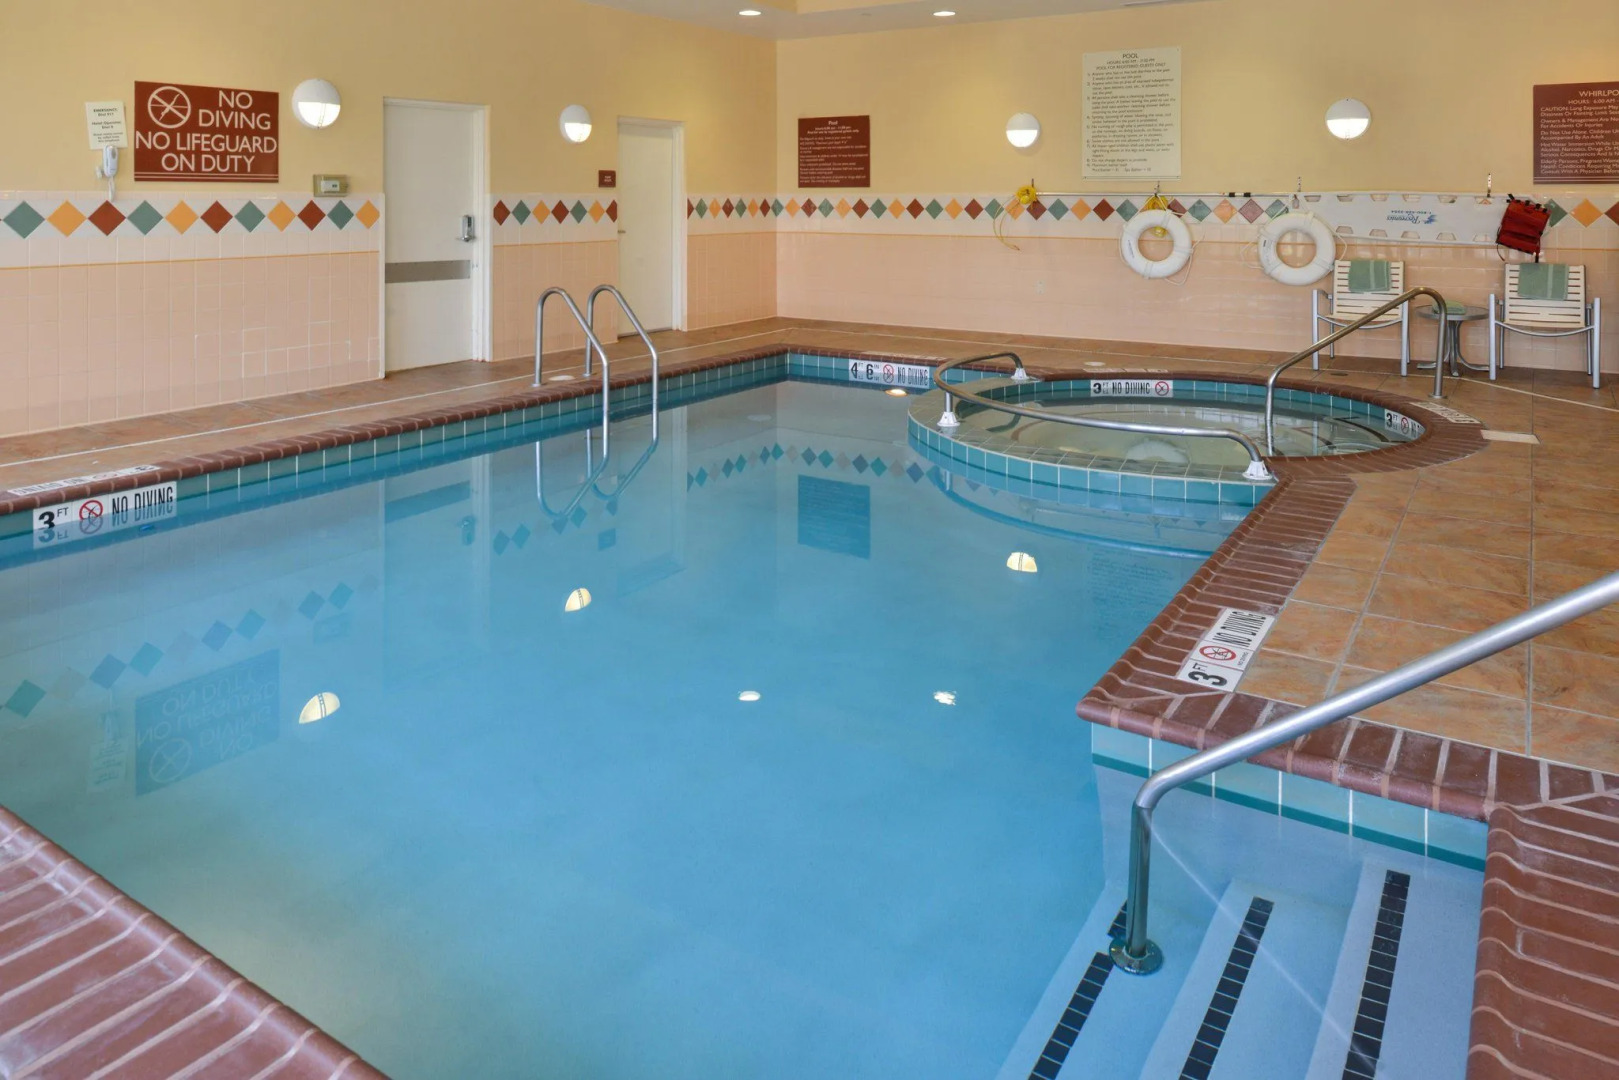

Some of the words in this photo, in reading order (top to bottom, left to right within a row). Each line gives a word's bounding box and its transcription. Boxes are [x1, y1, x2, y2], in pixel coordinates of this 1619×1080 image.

[218, 90, 253, 109] NO
[199, 108, 271, 130] DIVING
[135, 130, 170, 150] NO
[177, 132, 277, 153] LIFEGUARD
[161, 153, 195, 172] ON
[201, 154, 255, 172] DUTY
[866, 364, 874, 375] 6
[1093, 382, 1101, 394] 3
[1112, 382, 1122, 394] NO
[1386, 413, 1392, 427] 3
[112, 496, 128, 516] NO
[134, 486, 173, 511] DIVING
[38, 511, 56, 528] 3
[57, 506, 69, 517] FT
[1212, 632, 1252, 647] NO
[1192, 663, 1208, 672] FT
[1188, 671, 1227, 686] 3
